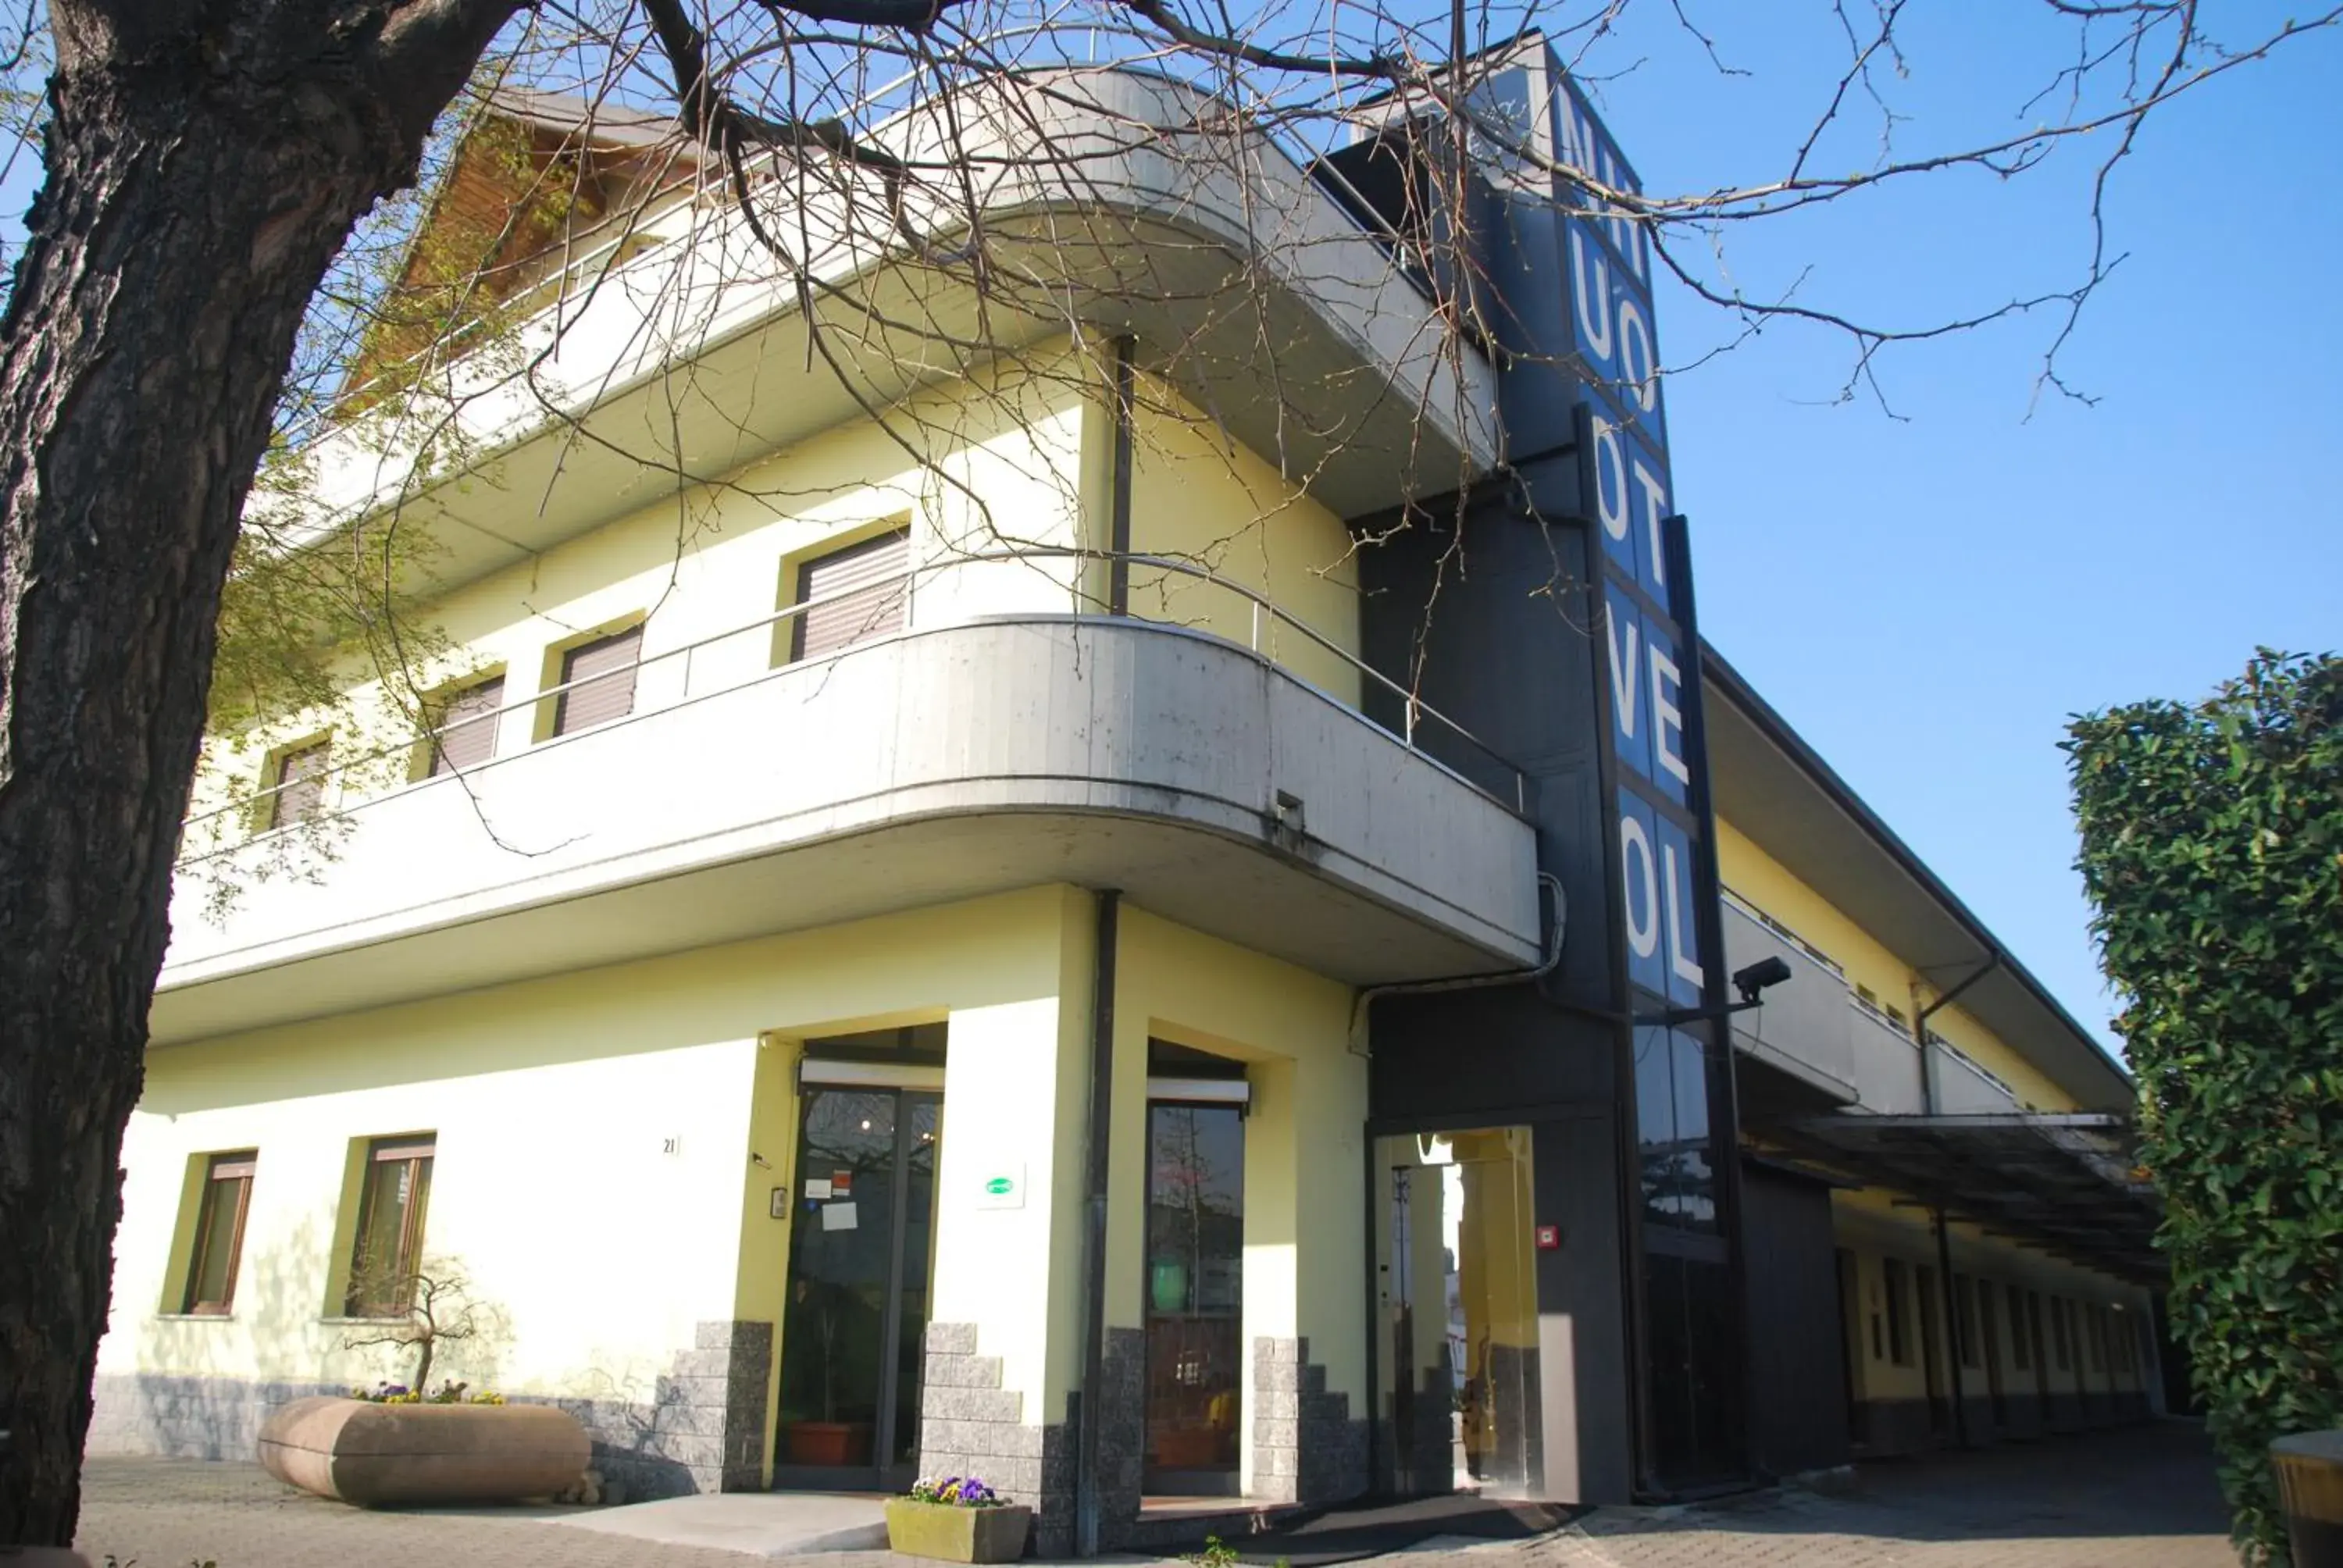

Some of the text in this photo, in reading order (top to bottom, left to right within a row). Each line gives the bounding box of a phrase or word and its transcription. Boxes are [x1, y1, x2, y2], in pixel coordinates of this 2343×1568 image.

[1557, 81, 1658, 959] NUOVO
[1603, 147, 1704, 989] HOTEL
[663, 1138, 675, 1153] 21
